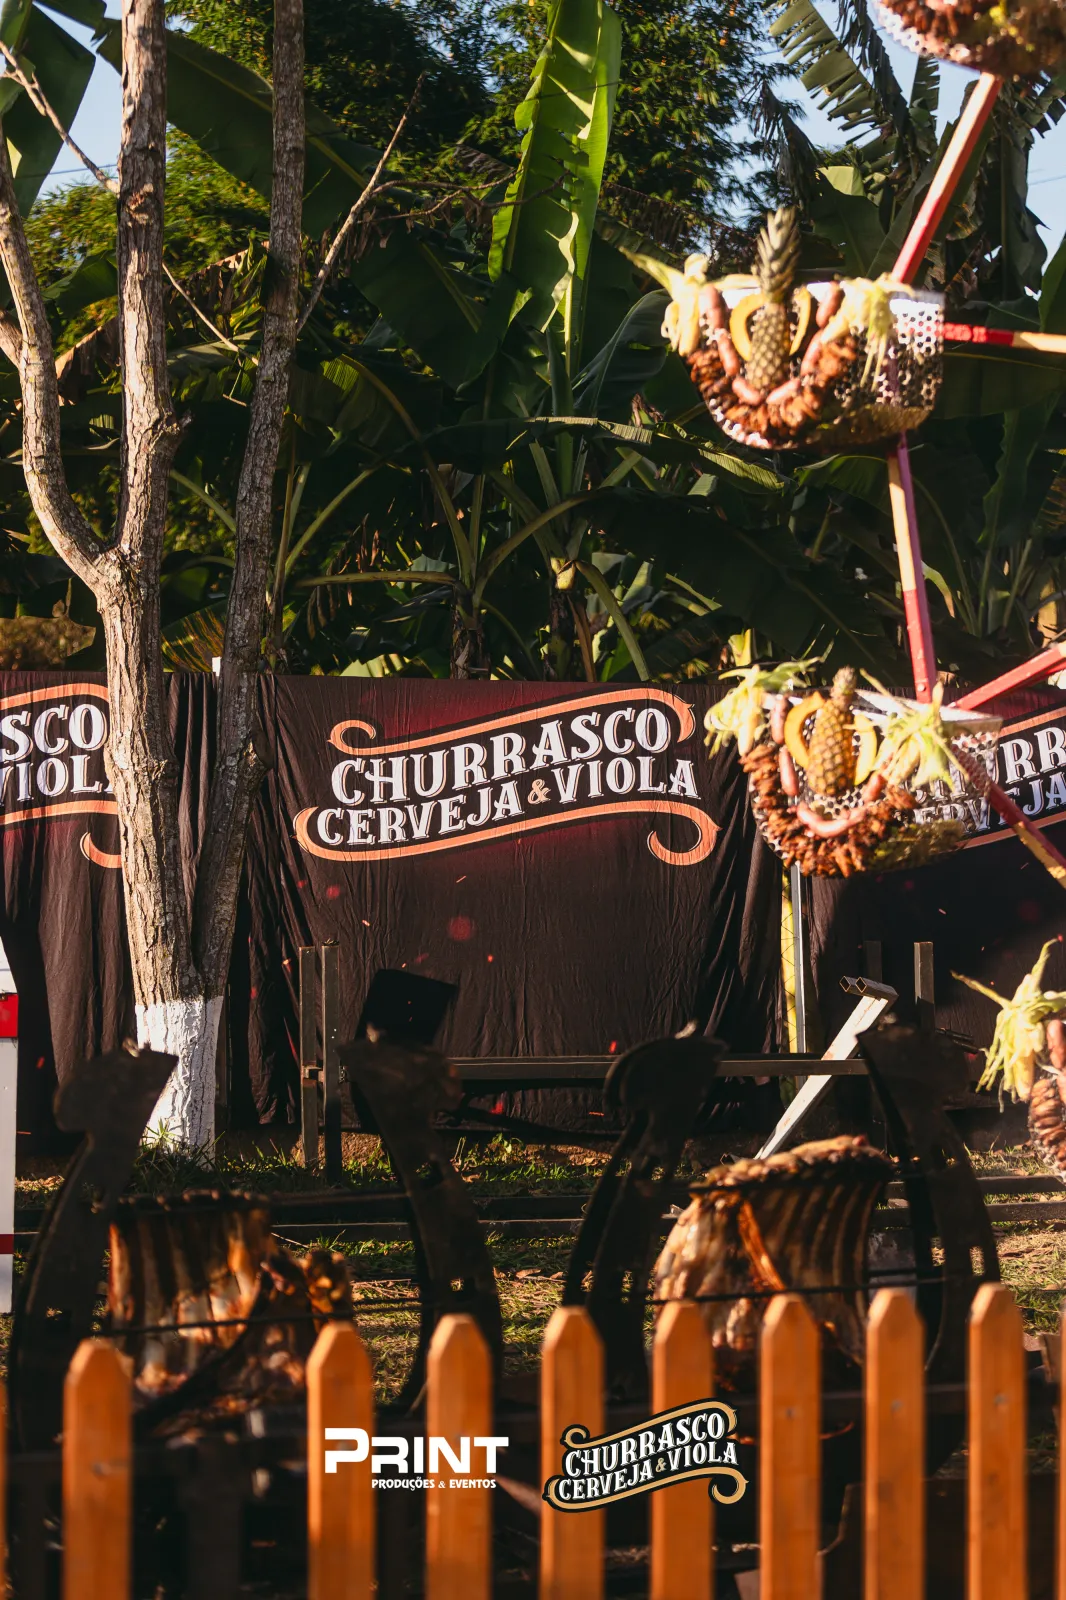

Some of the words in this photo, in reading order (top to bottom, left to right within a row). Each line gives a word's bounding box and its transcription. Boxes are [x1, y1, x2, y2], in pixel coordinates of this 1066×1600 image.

[0, 755, 113, 805] IOL
[316, 780, 525, 846] CERVEJA
[527, 778, 551, 805] &
[551, 756, 701, 804] VIOLA
[331, 707, 671, 806] CHURRASCO
